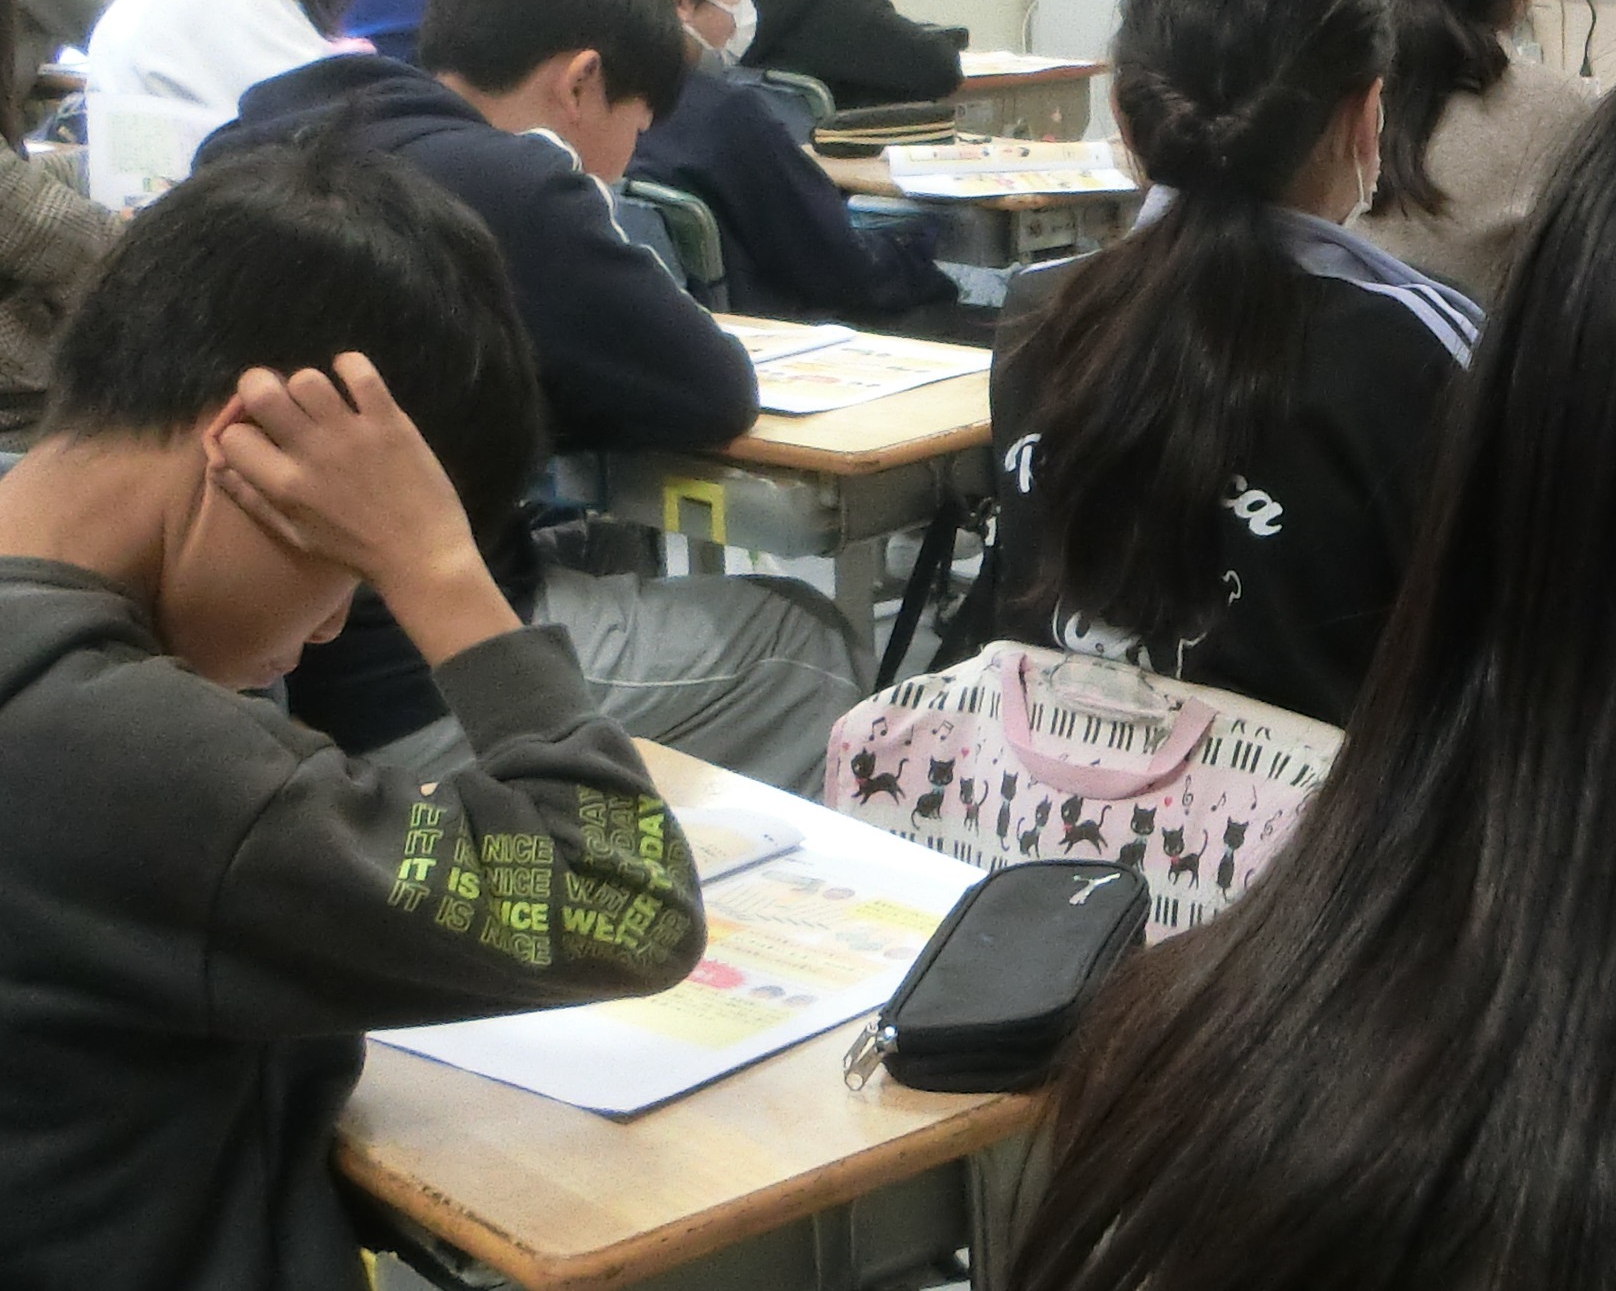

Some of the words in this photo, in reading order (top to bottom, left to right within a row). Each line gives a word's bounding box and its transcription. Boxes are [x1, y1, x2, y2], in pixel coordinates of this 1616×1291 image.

[481, 833, 554, 864] NICE
[397, 858, 438, 881] IT
[448, 866, 481, 900] IS
